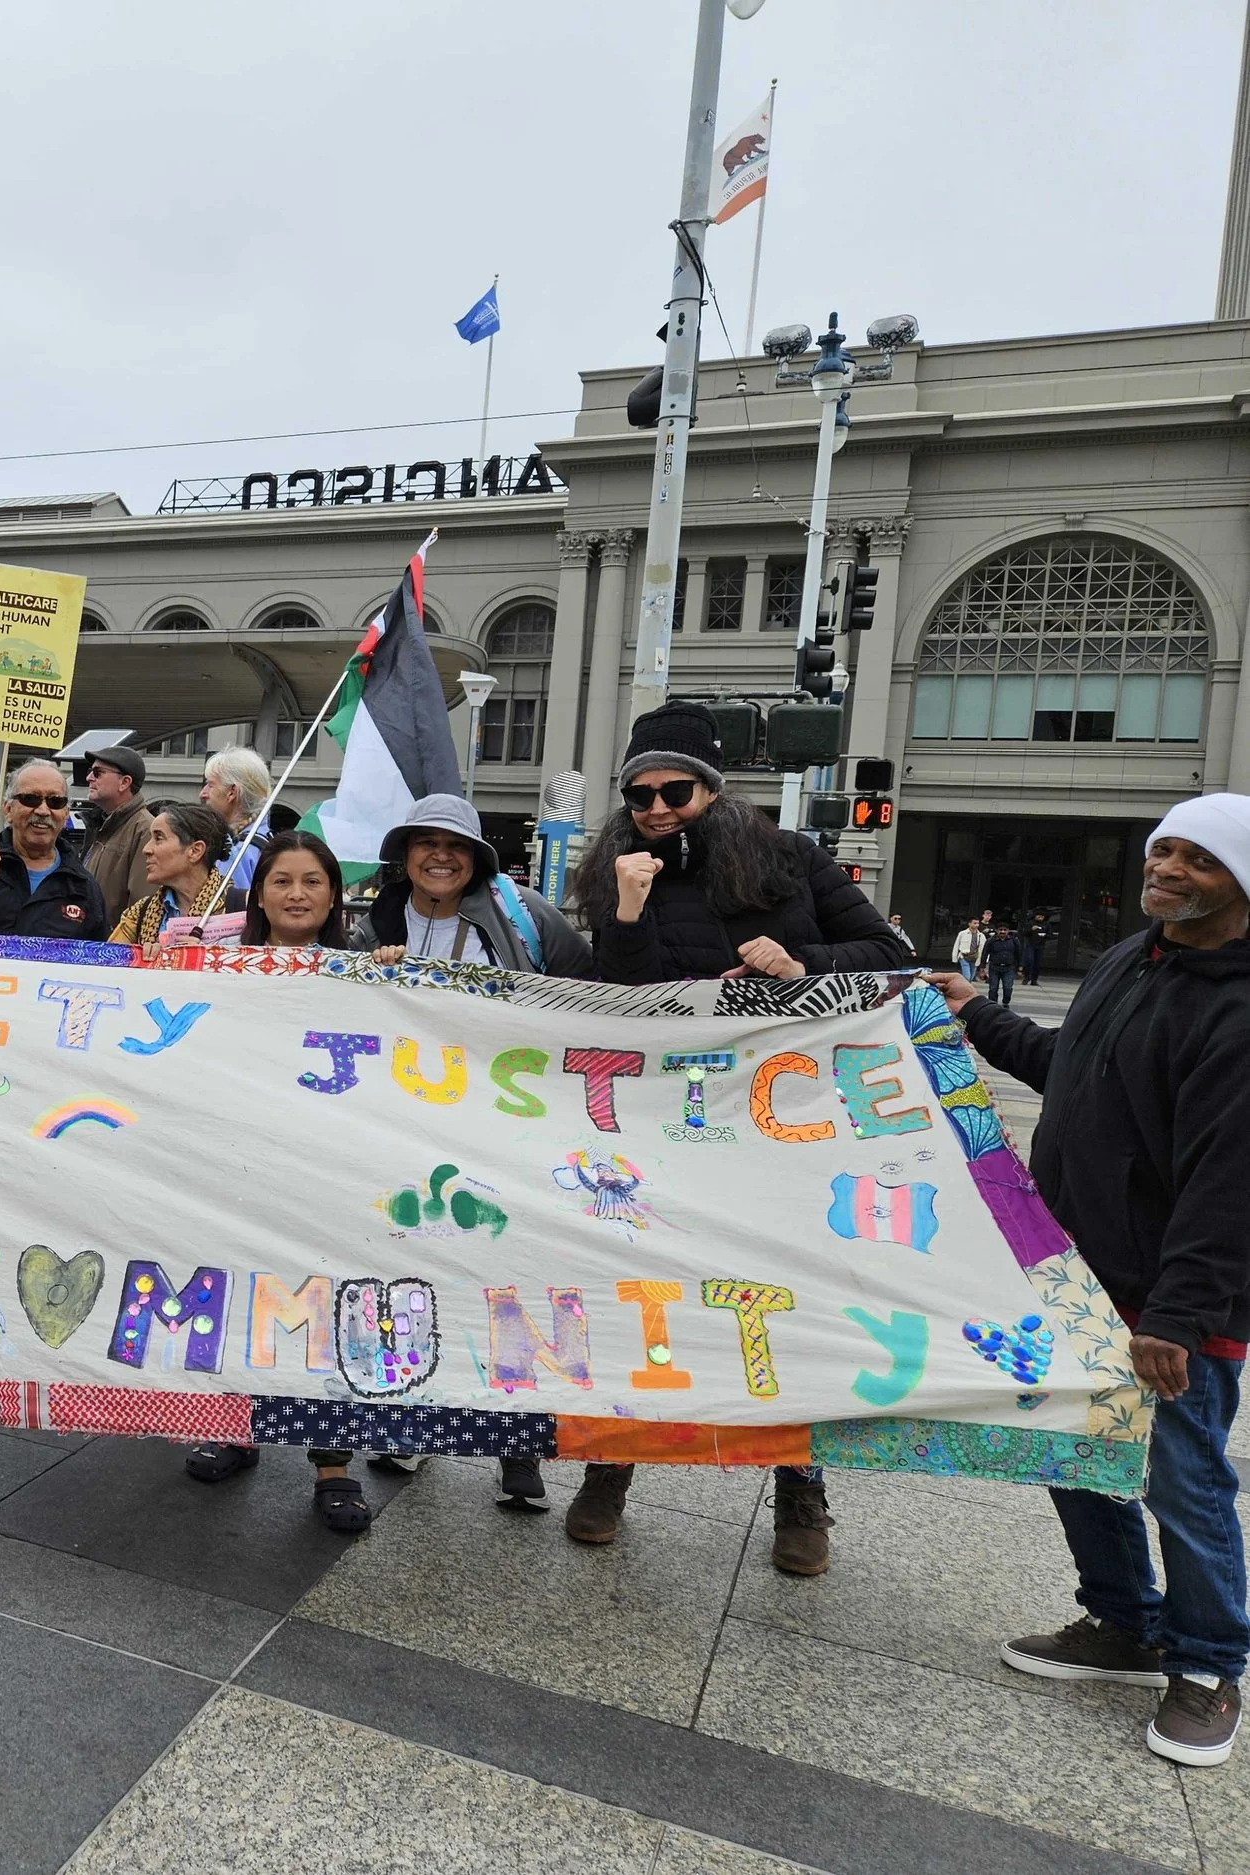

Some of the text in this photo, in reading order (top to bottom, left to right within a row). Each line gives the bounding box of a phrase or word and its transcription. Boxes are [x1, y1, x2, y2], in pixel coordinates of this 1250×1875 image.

[1, 611, 51, 627] HUMAN
[8, 679, 66, 697] LA SALUD
[5, 696, 41, 710] ES UN
[3, 708, 63, 726] DERECHO
[1, 721, 60, 738] HUMANO
[880, 803, 892, 823] 8
[551, 840, 561, 866] HERE
[853, 868, 860, 881] 8
[297, 1030, 933, 1144] JUSTICE
